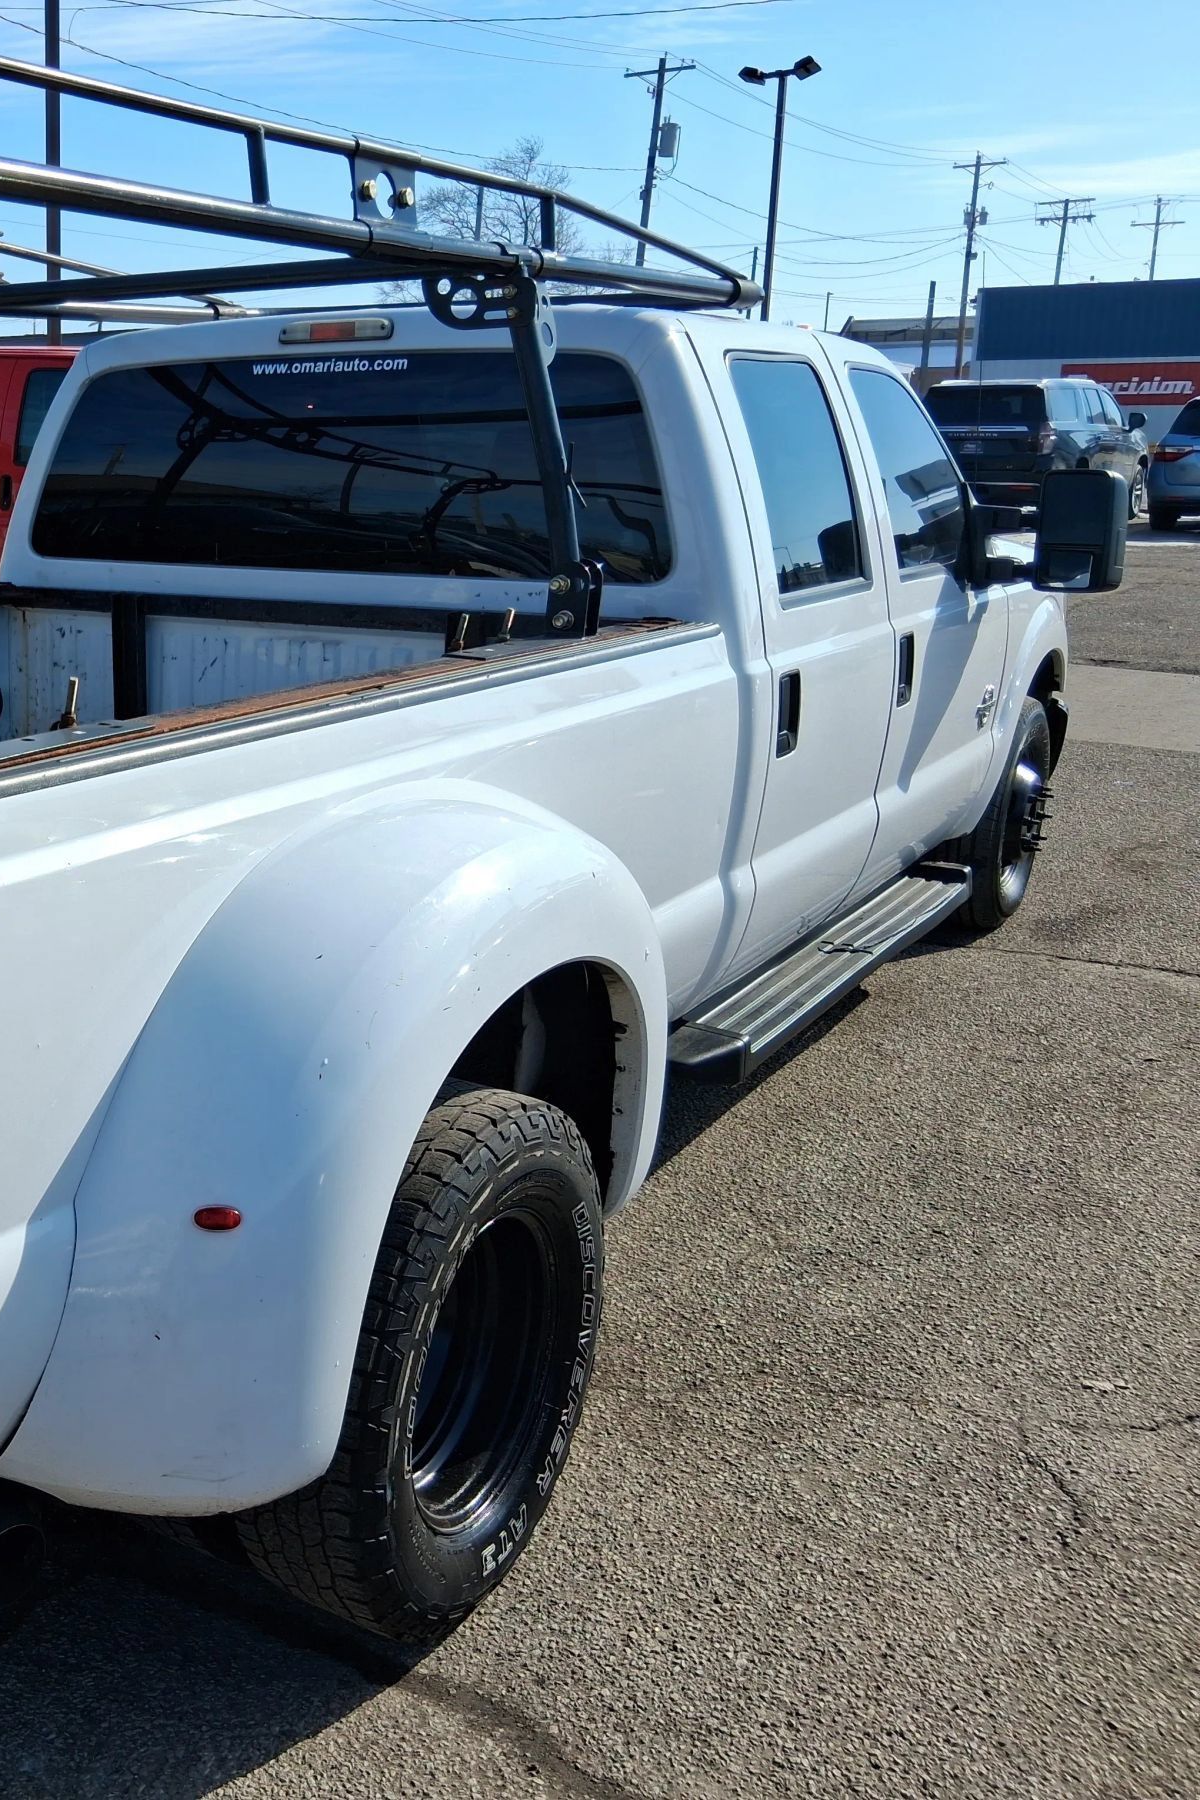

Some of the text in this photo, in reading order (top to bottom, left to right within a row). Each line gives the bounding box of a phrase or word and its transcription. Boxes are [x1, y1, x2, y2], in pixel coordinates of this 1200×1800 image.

[253, 357, 408, 376] www.omariauto.com
[1067, 375, 1193, 396] cision
[482, 1201, 597, 1577] DISCOVERER AT3
